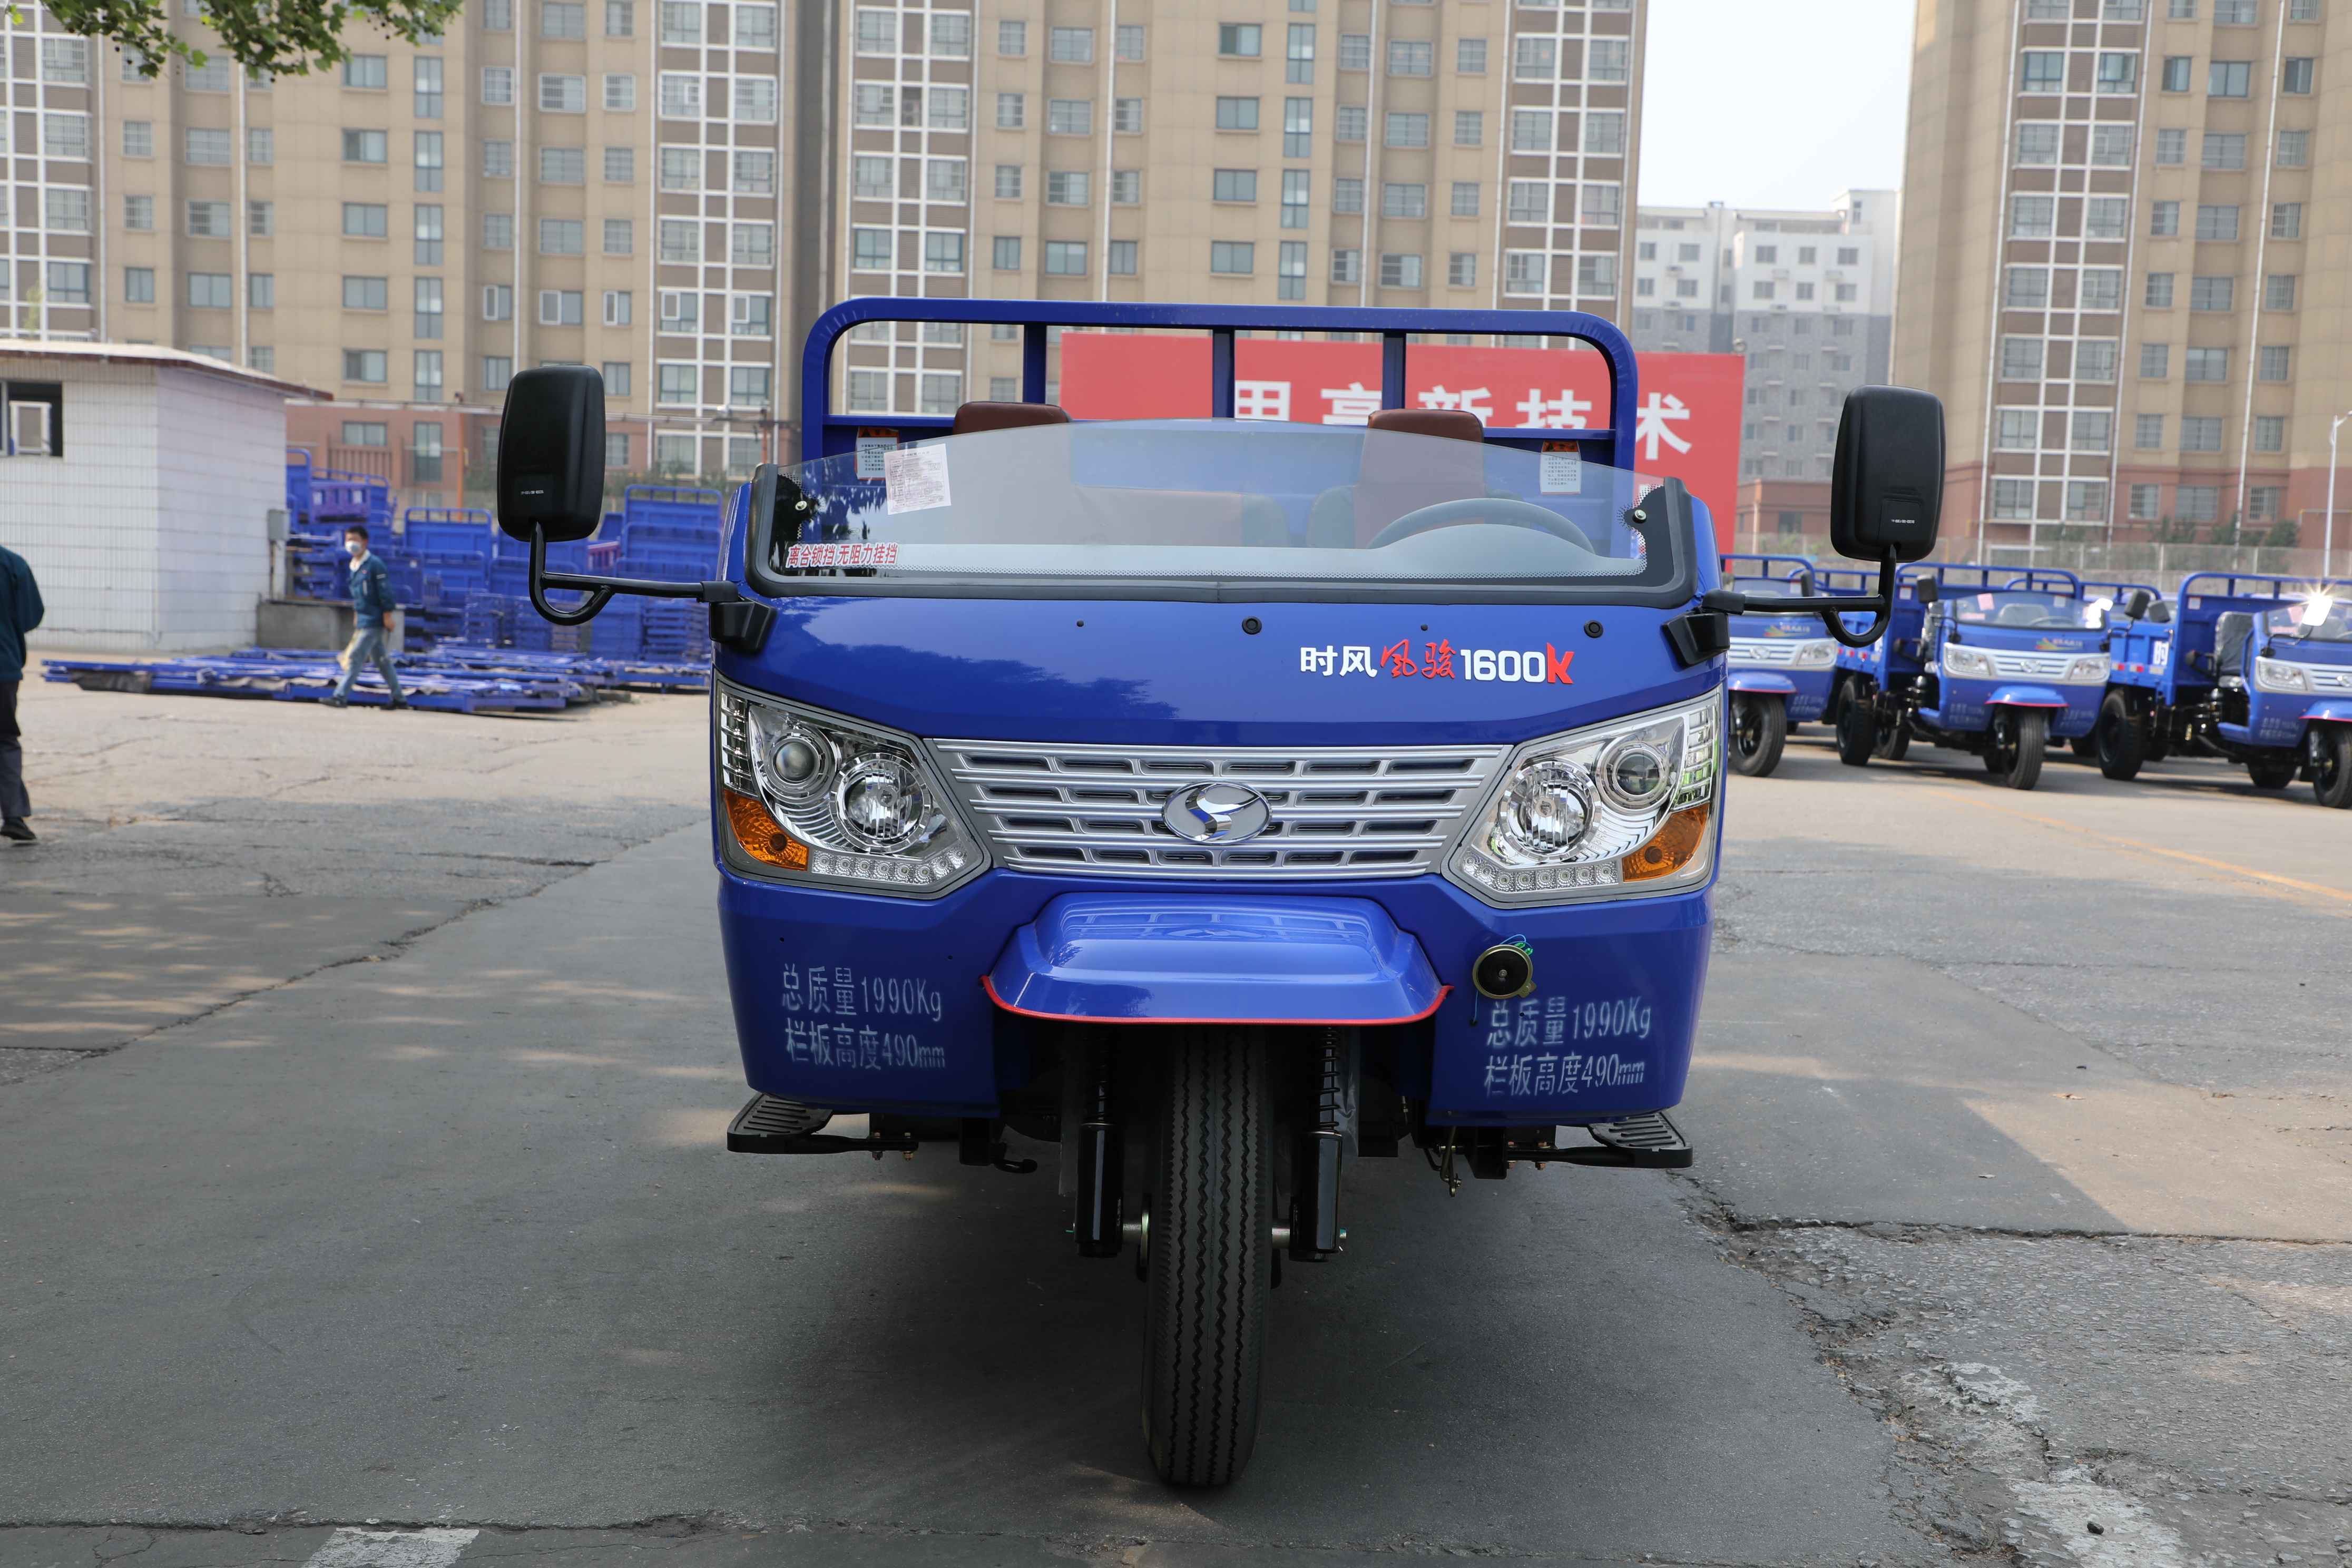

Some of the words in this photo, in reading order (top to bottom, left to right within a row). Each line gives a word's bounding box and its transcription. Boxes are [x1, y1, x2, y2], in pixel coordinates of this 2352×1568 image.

[787, 545, 836, 567] 离合锁挡
[836, 543, 898, 565] 无阻力挂挡
[782, 963, 942, 1021] 总质量1990Kg
[785, 1017, 945, 1070] 栏板高度490mm
[1486, 996, 1651, 1047] 总质量1990Kg
[1484, 1051, 1645, 1097] 栏板高度490mm
